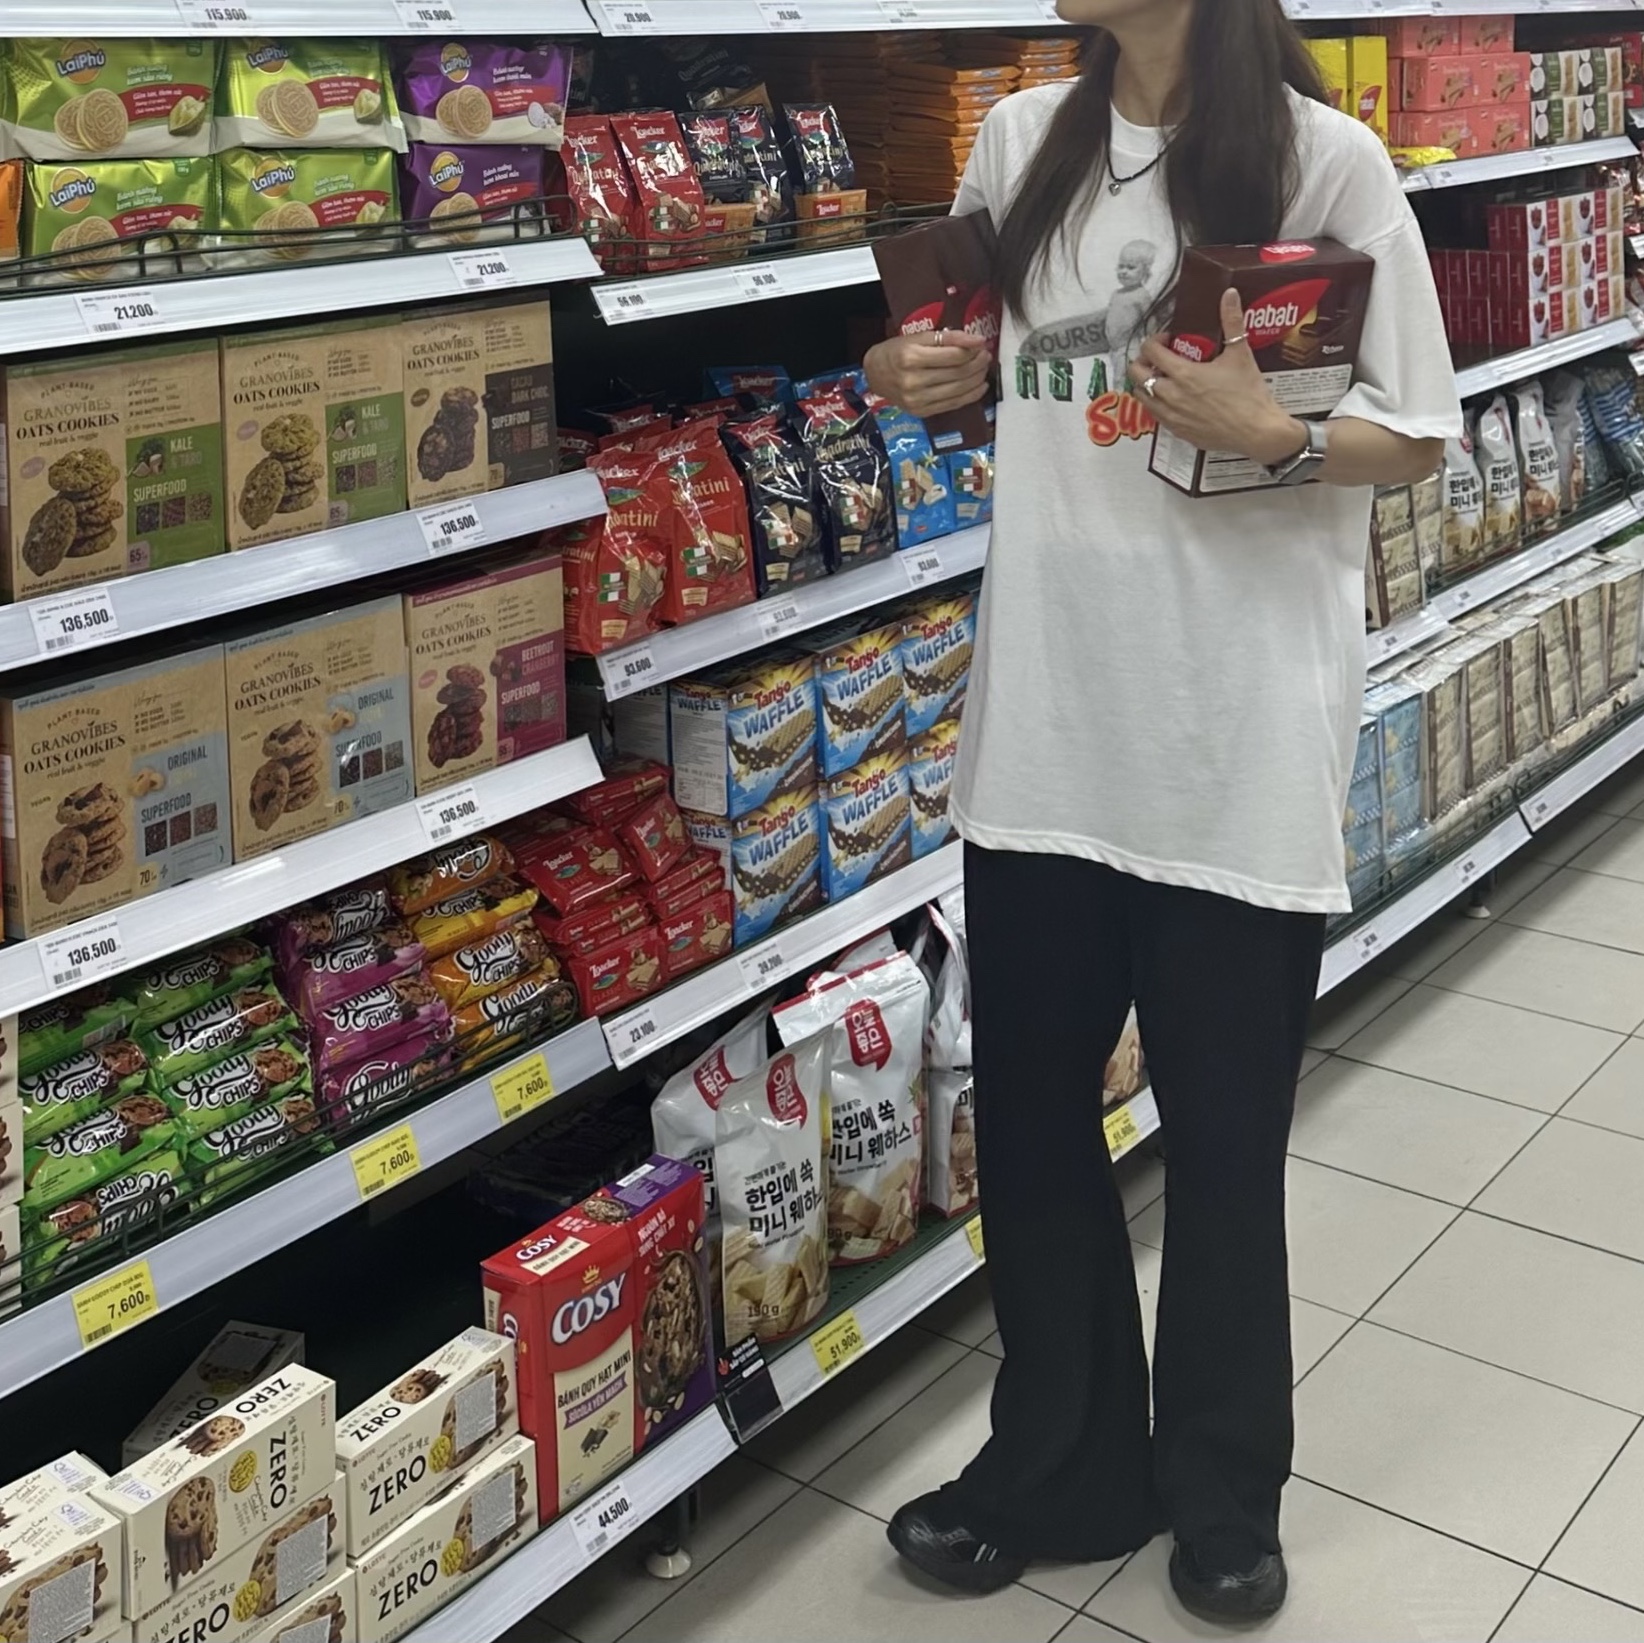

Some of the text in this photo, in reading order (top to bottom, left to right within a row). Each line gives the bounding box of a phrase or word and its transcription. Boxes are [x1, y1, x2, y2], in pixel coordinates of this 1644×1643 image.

[56, 49, 105, 75] LaiPhú
[441, 55, 472, 74] LaiPhú
[252, 167, 295, 192] LaiPhú
[429, 161, 464, 187] LaiPhú
[50, 178, 95, 207] LaiPhú
[114, 303, 154, 320] 21,200
[1243, 302, 1299, 329] nabati
[901, 317, 934, 336] nabati
[413, 337, 474, 356] GRANOVIBES
[1173, 337, 1202, 360] nabati
[407, 350, 480, 371] OATS COOKIES
[240, 367, 314, 388] GRANOVIBES
[233, 381, 320, 405] OATS COOKIES
[24, 398, 111, 422] GRANOVIBES
[362, 404, 380, 418] KALE
[492, 411, 530, 429] SUPERFOOD
[806, 401, 846, 418] Loacker
[16, 413, 120, 440] OATS COOKIES
[170, 437, 193, 452] KALE
[332, 444, 377, 464] SUPERFOOD
[658, 440, 698, 461] Loacker
[133, 479, 187, 502] SUPERFOOD
[440, 515, 476, 535] 136,500
[60, 609, 109, 633] 136,500
[421, 614, 486, 640] GRANOVIBES
[920, 615, 953, 638] Tango
[416, 627, 491, 655] OATS COOKIES
[912, 622, 965, 666] WAFFLE
[845, 647, 880, 675] Tango
[240, 663, 314, 694] GRANOVIBES
[837, 654, 892, 701] WAFFLE
[235, 676, 321, 711] OATS COOKIES
[358, 688, 394, 710] ORIGINAL
[501, 681, 541, 705] SUPERFOOD
[677, 698, 721, 712] WAFFLE
[754, 681, 792, 710] Tango
[744, 688, 805, 739] WAFFLE
[31, 720, 118, 755] GRANOVIBES
[24, 735, 126, 775] OATS COOKIES
[167, 745, 208, 771] ORIGINAL
[851, 769, 886, 798] Tango
[141, 793, 192, 824] SUPERFOOD
[440, 800, 476, 825] 136,500
[842, 775, 898, 826] WAFFLE
[758, 805, 796, 836] Tango
[749, 811, 809, 866] WAFFLE
[543, 851, 574, 870] Loacker
[664, 920, 694, 941] Loacker
[67, 938, 117, 966] 136,500
[343, 952, 378, 972] CHIPS
[456, 932, 517, 984] Goody
[183, 957, 221, 987] CHIPS
[590, 956, 621, 978] Loacker
[157, 994, 238, 1052] Goody
[368, 1005, 401, 1030] CHIPS
[206, 1019, 243, 1050] CHIPS
[71, 1071, 109, 1099] CHIPS
[173, 1053, 254, 1107] Goody
[222, 1076, 261, 1106] CHIPS
[878, 1099, 896, 1122] 쏙
[745, 1158, 814, 1213] 한입에 쏙
[749, 1205, 787, 1238] 미니
[516, 1234, 558, 1262] COSY
[552, 1272, 627, 1344] COSY
[558, 1349, 631, 1408] BÁNH QUY HẠT MINI
[236, 1378, 292, 1413] ZERO
[350, 1406, 402, 1442] ZERO
[270, 1431, 287, 1509] ZERO
[369, 1454, 426, 1516] ZERO
[378, 1558, 438, 1622] ZERO
